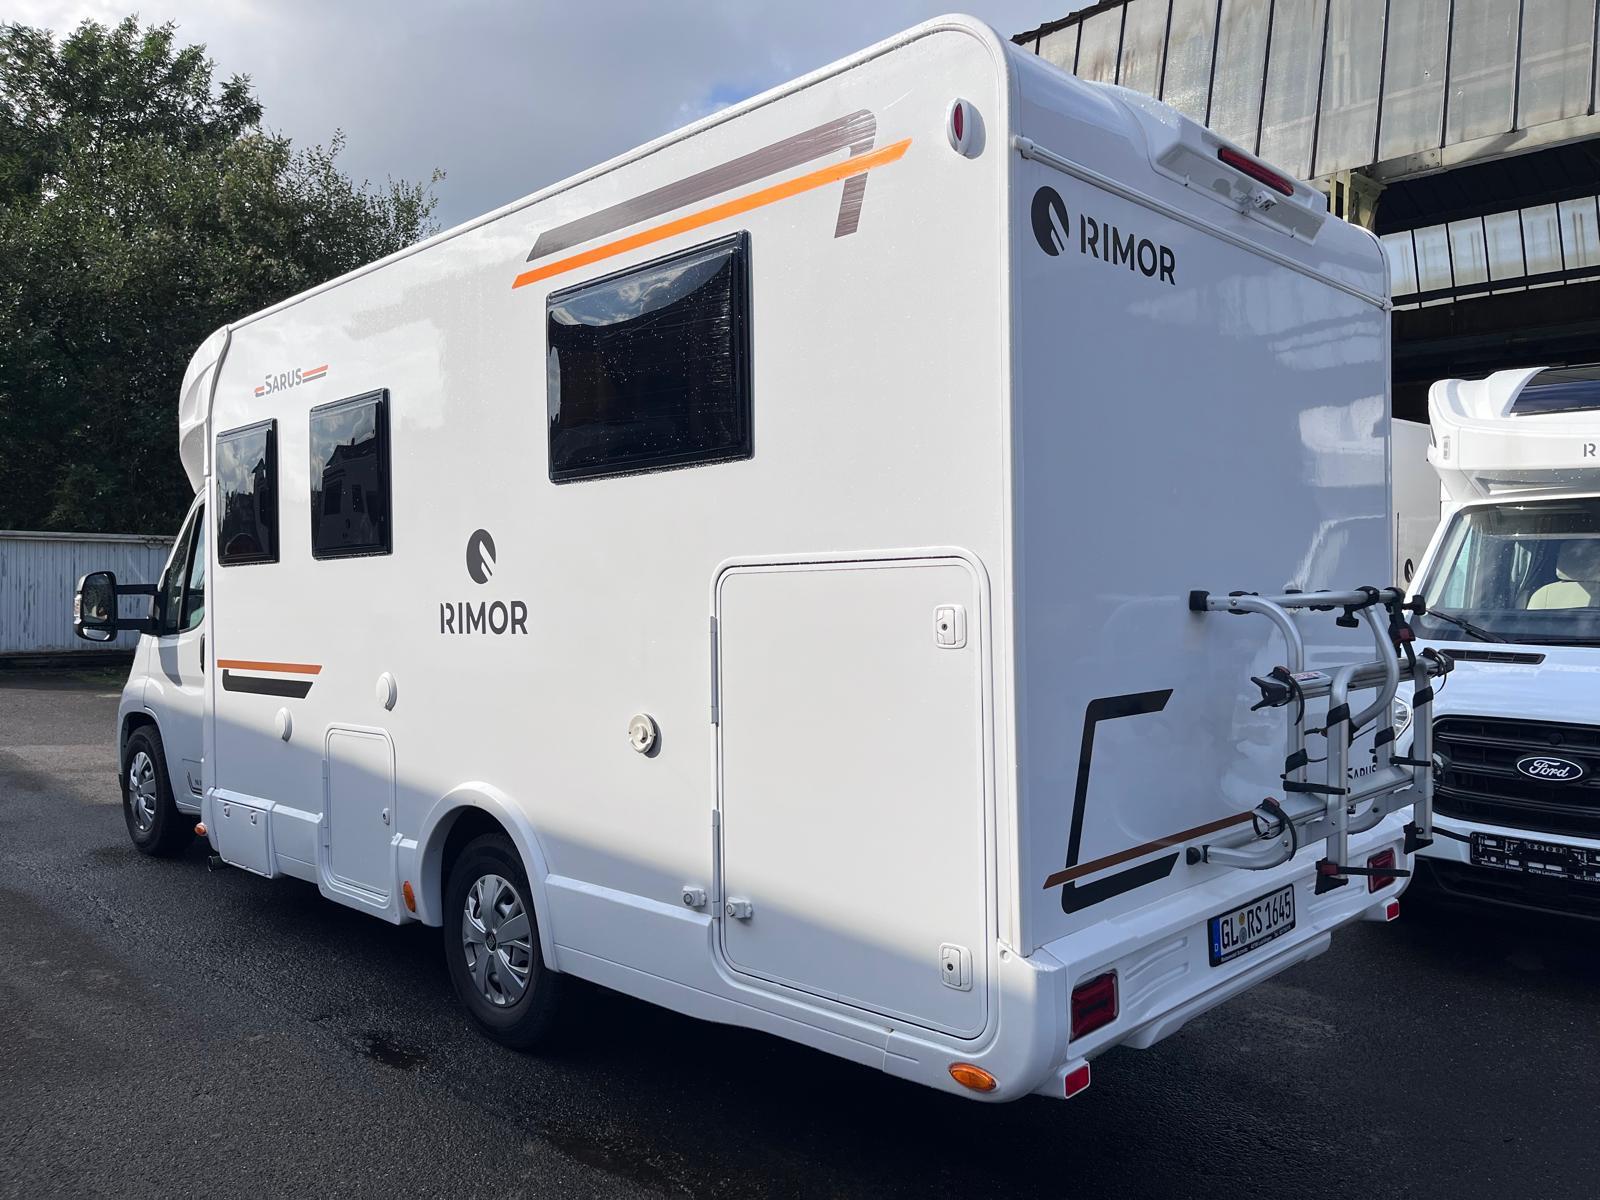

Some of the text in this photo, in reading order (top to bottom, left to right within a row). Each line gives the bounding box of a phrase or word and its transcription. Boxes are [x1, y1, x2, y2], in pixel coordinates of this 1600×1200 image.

[1080, 213, 1176, 286] RIMOR
[265, 367, 302, 395] SARUS
[440, 600, 528, 635] RIMOR
[1528, 759, 1571, 778] Ford
[1221, 891, 1291, 949] GL RS 1645
[1214, 943, 1219, 952] D
